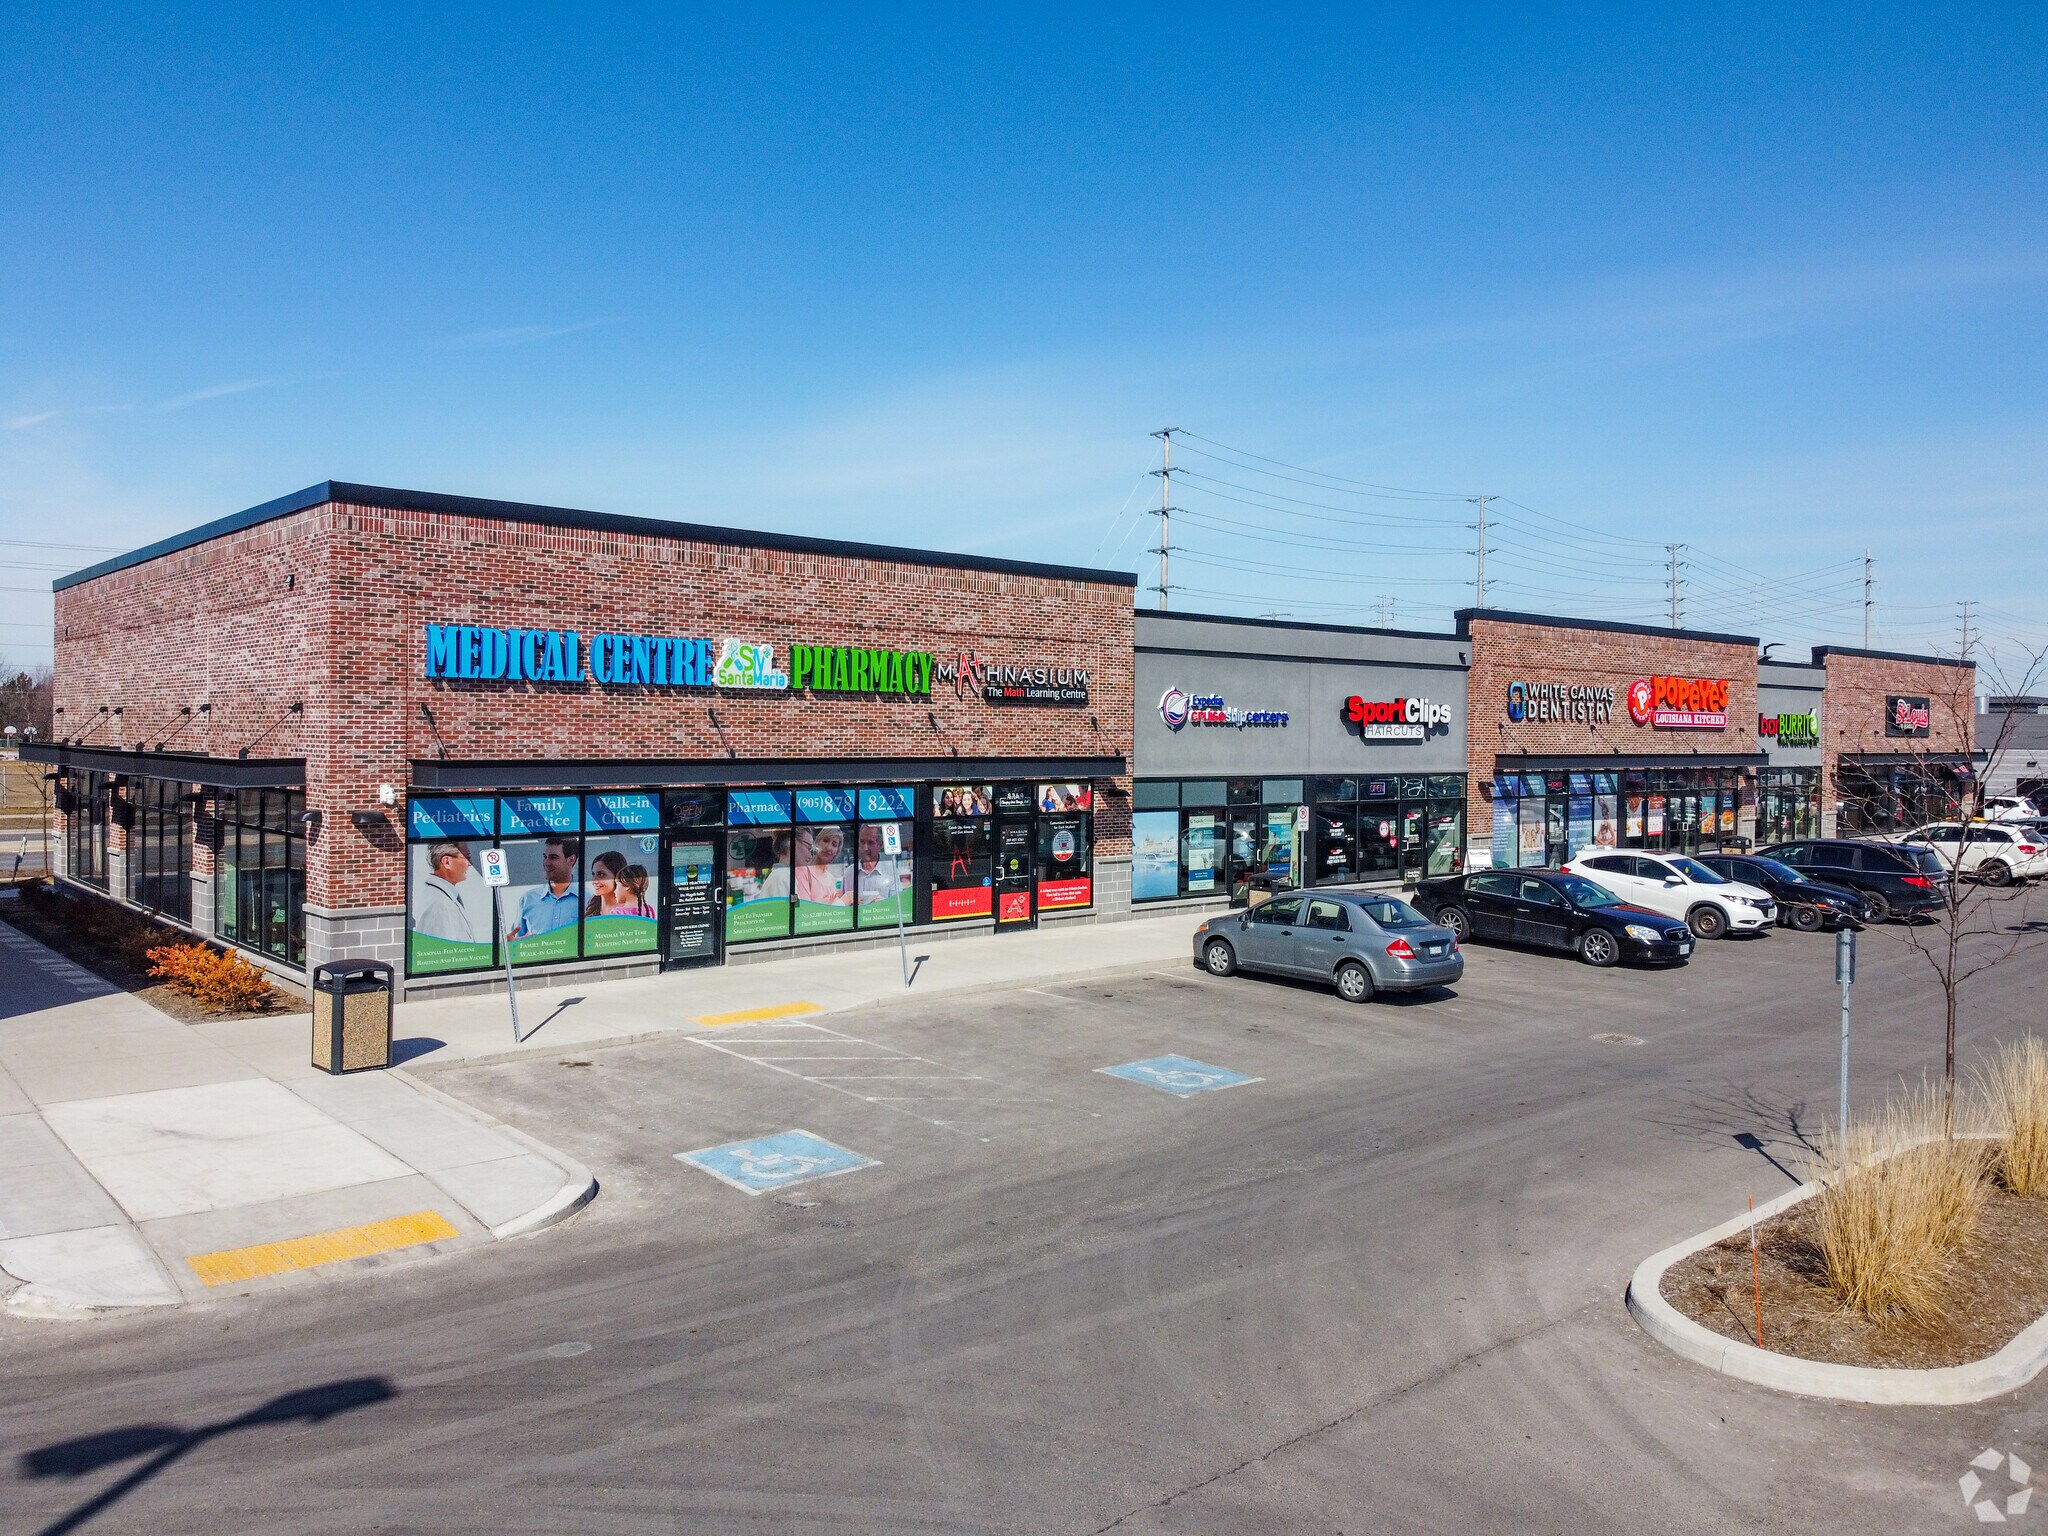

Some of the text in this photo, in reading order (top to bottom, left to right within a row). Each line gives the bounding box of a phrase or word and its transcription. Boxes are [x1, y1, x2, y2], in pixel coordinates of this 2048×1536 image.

[424, 624, 712, 687] MEDICAL CENTRE
[790, 645, 933, 694] PHARMACY
[987, 687, 1086, 701] The Math Learning Centre
[1528, 683, 1614, 701] WHITE CANVAS
[1528, 700, 1613, 720] DENTISTRY
[1655, 713, 1725, 725] LOUISIANA KITCHEN
[1366, 727, 1422, 736] HAIRCUTS
[517, 797, 564, 814] Family
[597, 796, 650, 809] Walk-in
[868, 794, 904, 811] 8222
[413, 810, 490, 825] Pediatrics
[674, 805, 703, 816] OPEN
[510, 814, 570, 828] Practice
[601, 811, 642, 825] Clinic
[541, 939, 566, 947] PRACTICE
